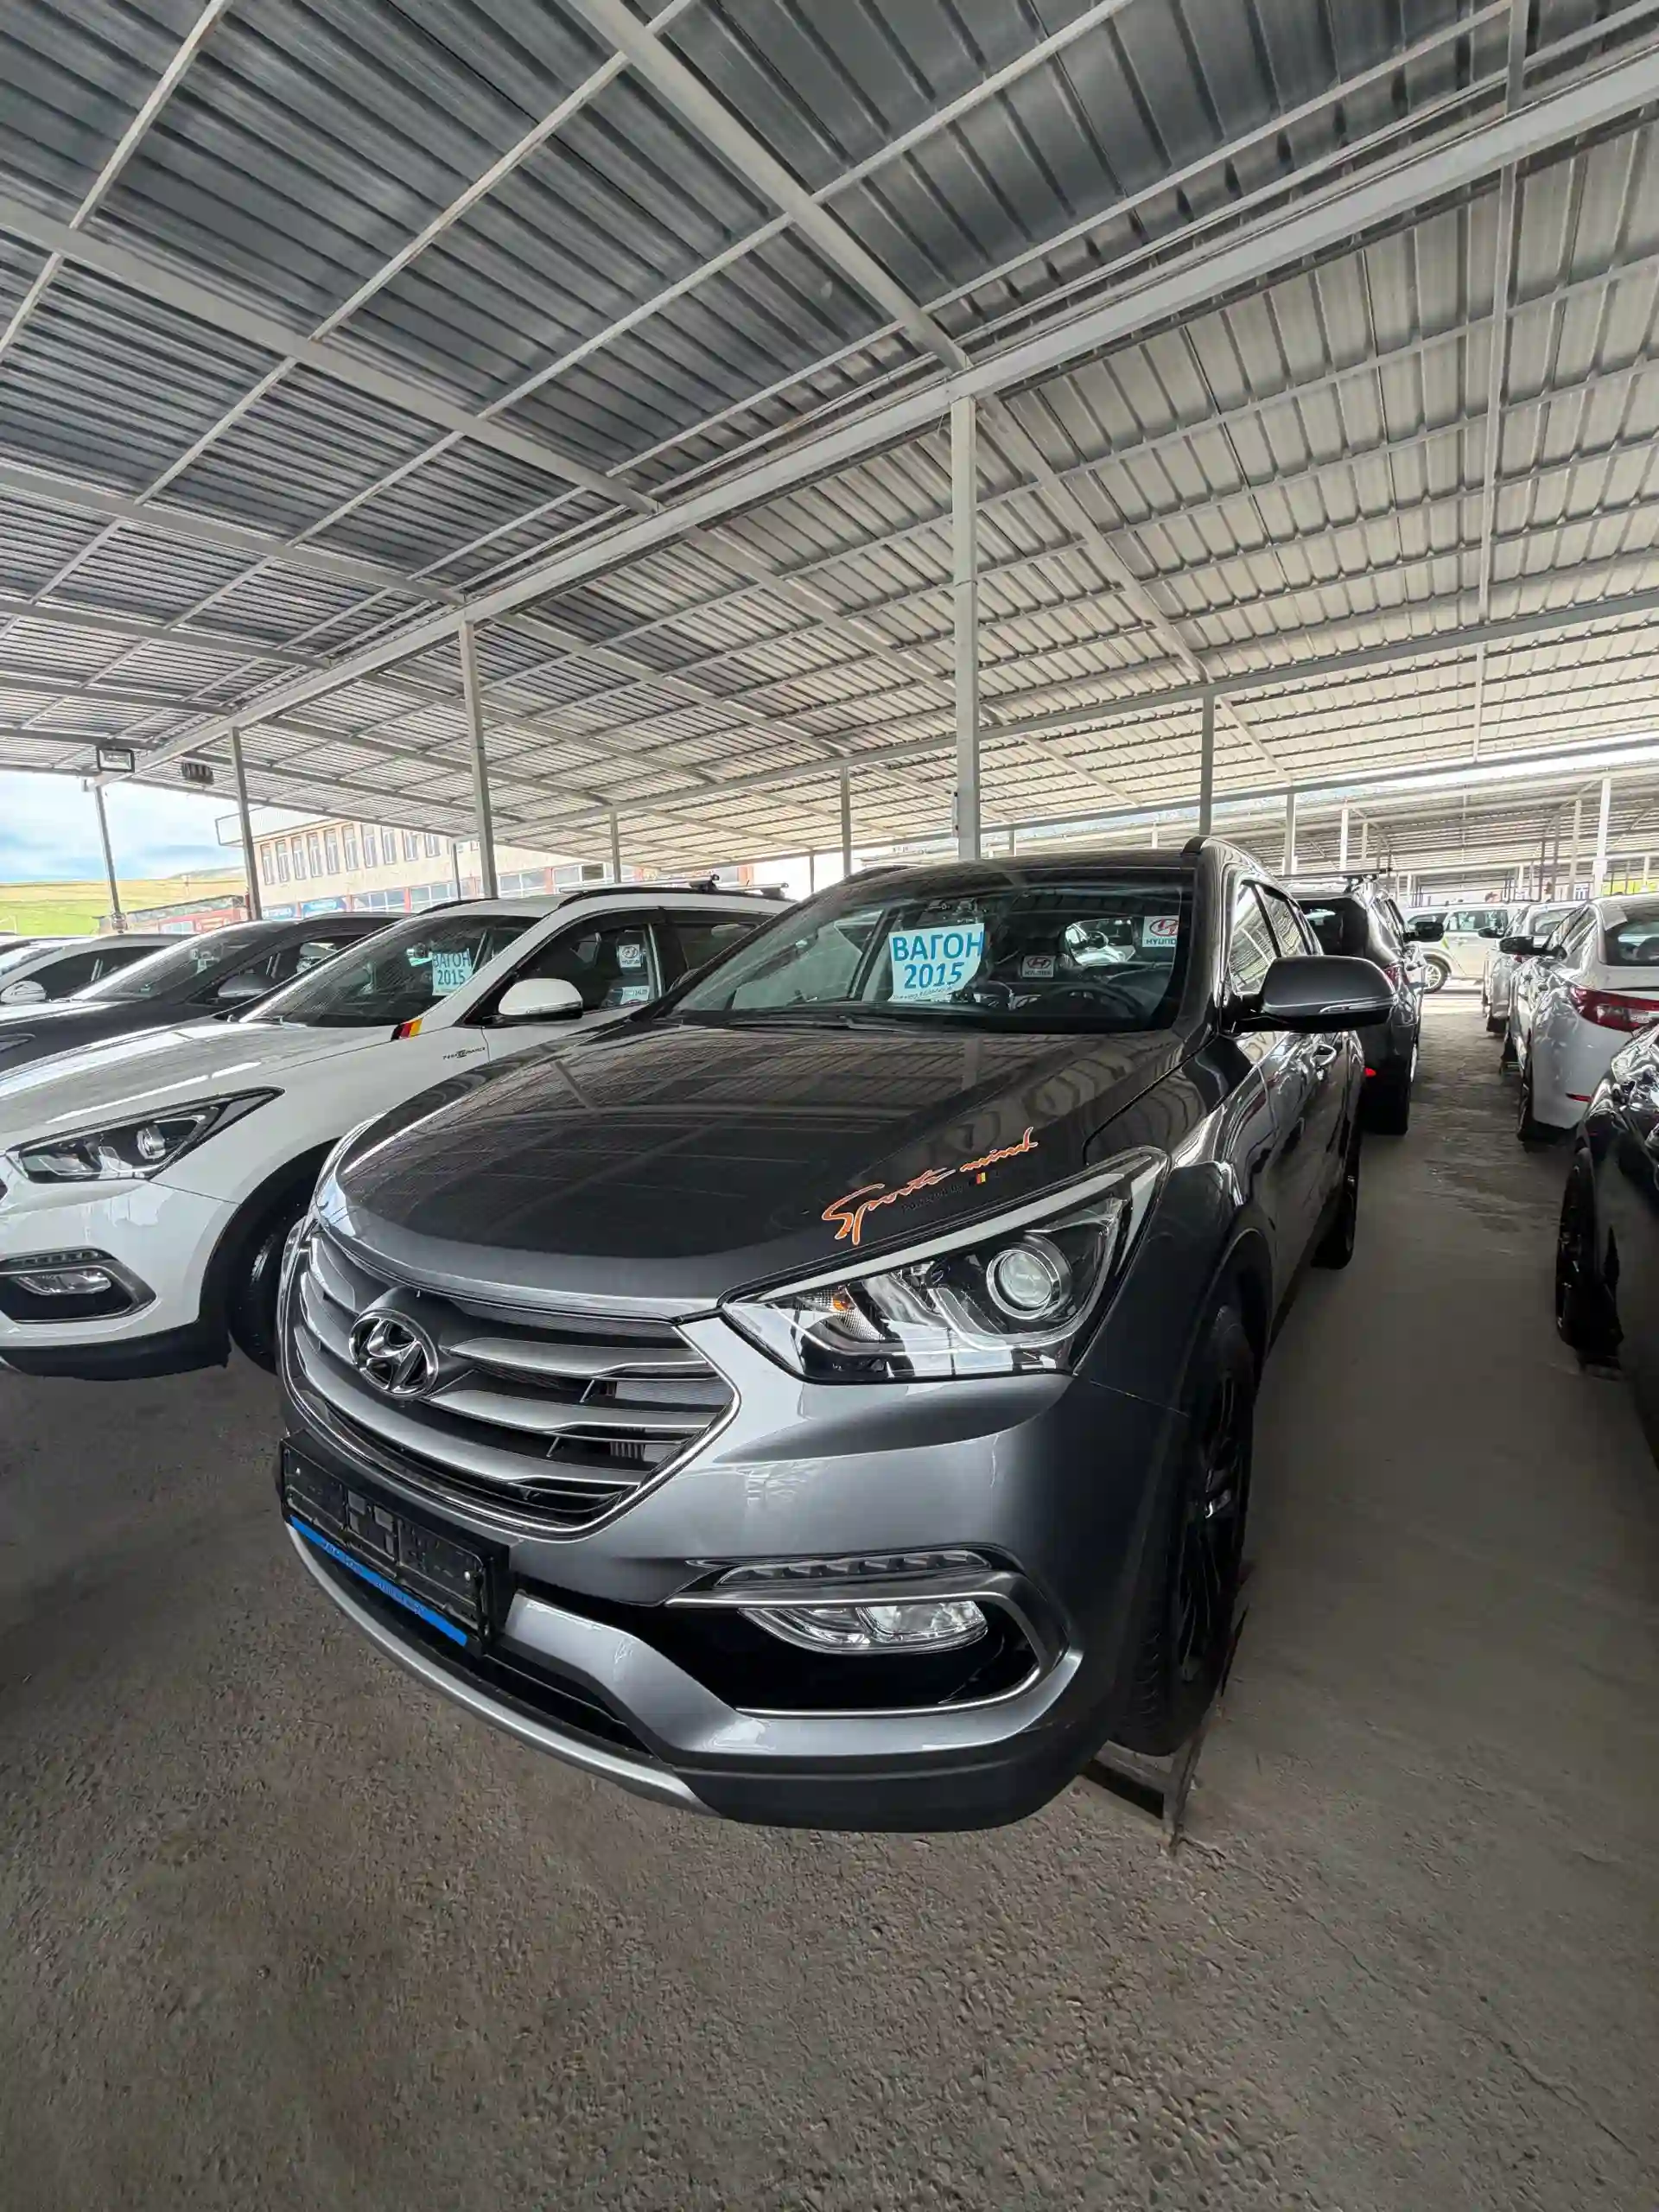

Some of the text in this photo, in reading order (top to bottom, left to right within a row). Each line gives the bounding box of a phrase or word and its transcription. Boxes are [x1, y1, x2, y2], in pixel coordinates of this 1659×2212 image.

[892, 931, 984, 962] ВАГОН
[437, 969, 466, 985] 2015
[904, 962, 965, 989] 2015
